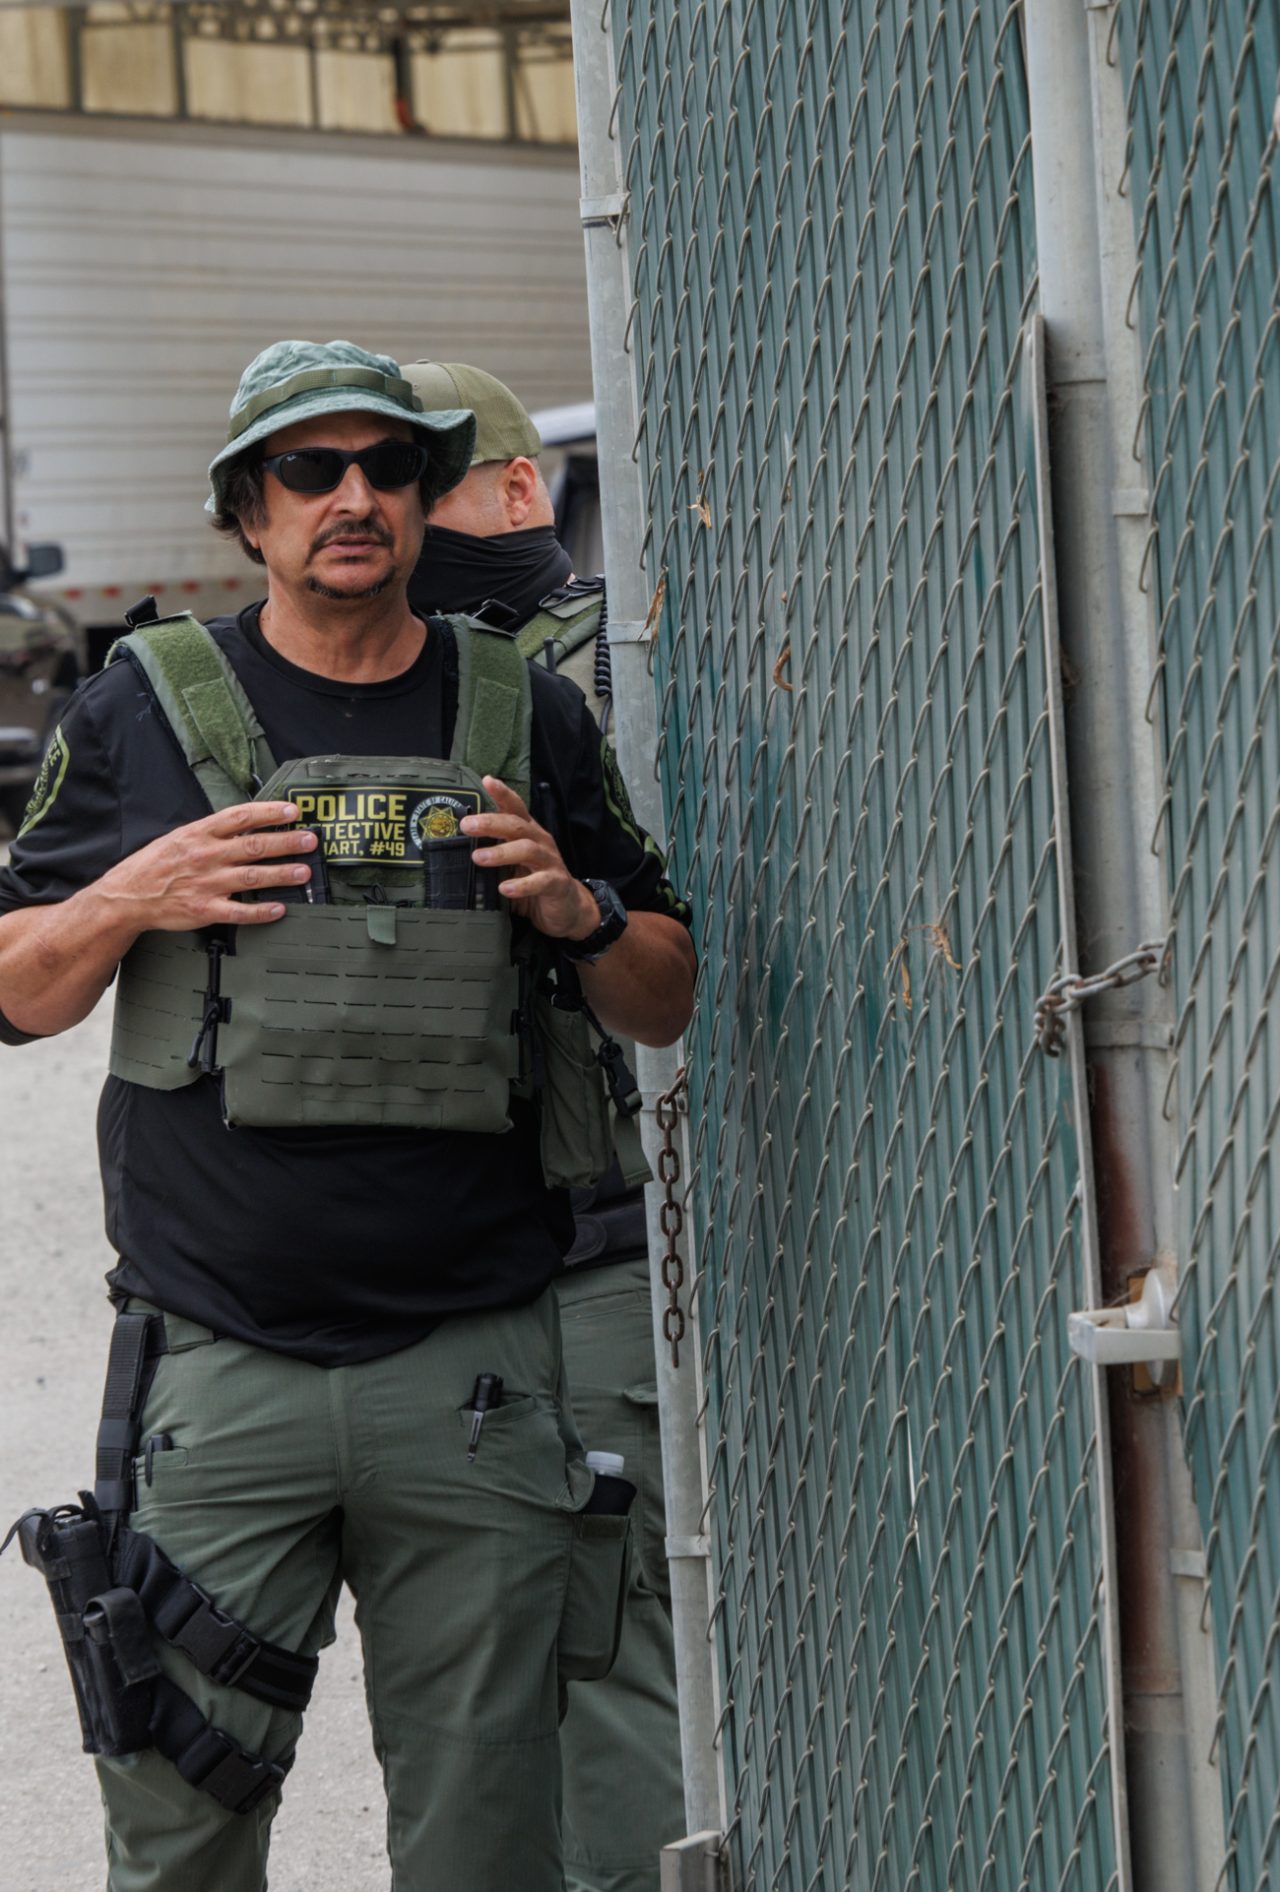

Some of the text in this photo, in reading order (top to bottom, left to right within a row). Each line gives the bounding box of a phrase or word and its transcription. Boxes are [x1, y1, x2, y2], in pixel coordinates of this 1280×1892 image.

[296, 794, 407, 822] POLICE
[296, 822, 406, 840] TECTIVE
[370, 841, 405, 856] #49
